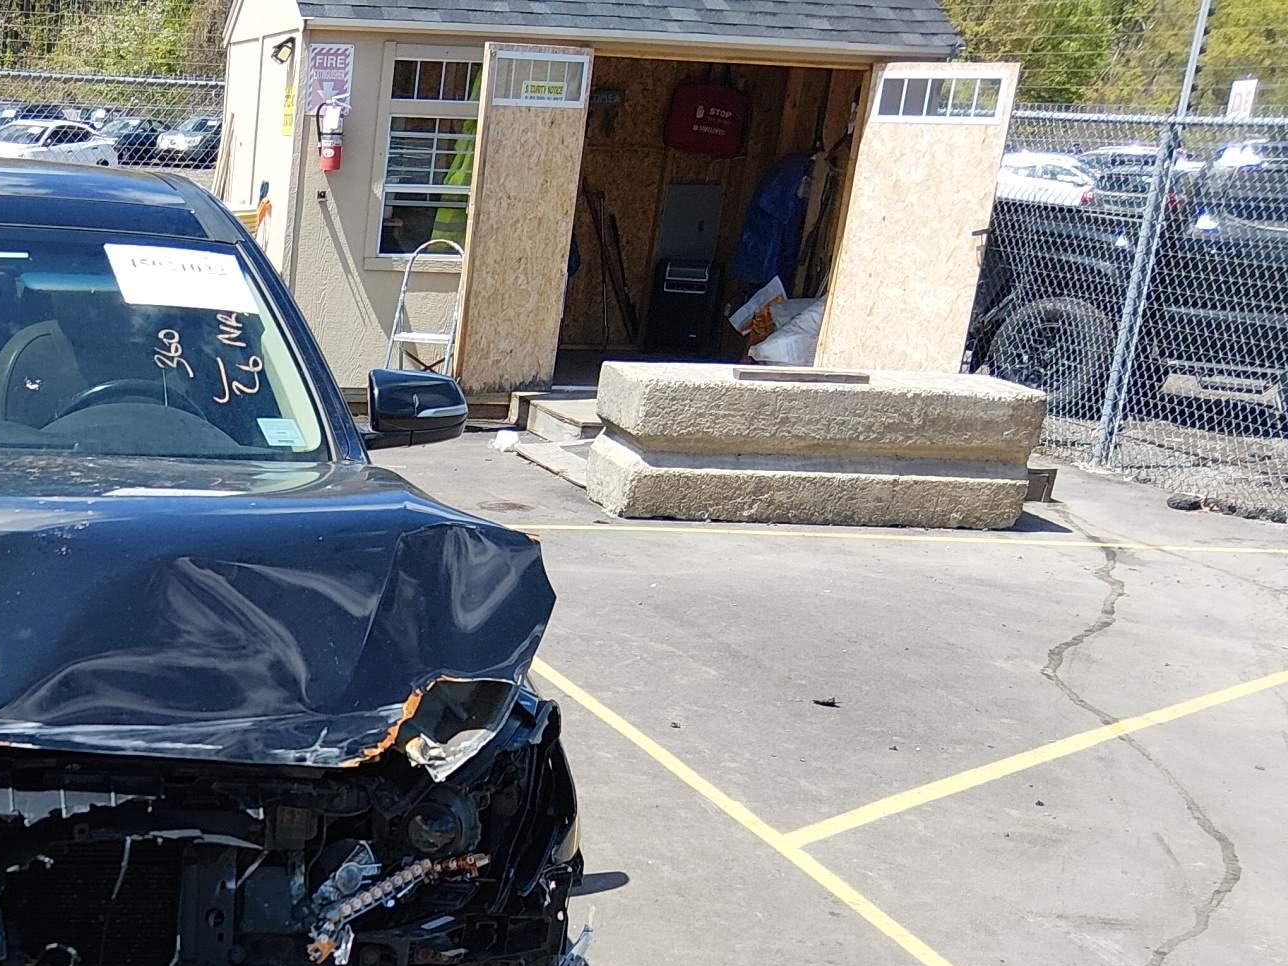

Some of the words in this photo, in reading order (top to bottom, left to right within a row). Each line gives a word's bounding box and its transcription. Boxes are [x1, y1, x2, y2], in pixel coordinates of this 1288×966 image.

[315, 55, 345, 68] FIRE
[709, 107, 732, 119] STOP
[153, 328, 194, 378] 360
